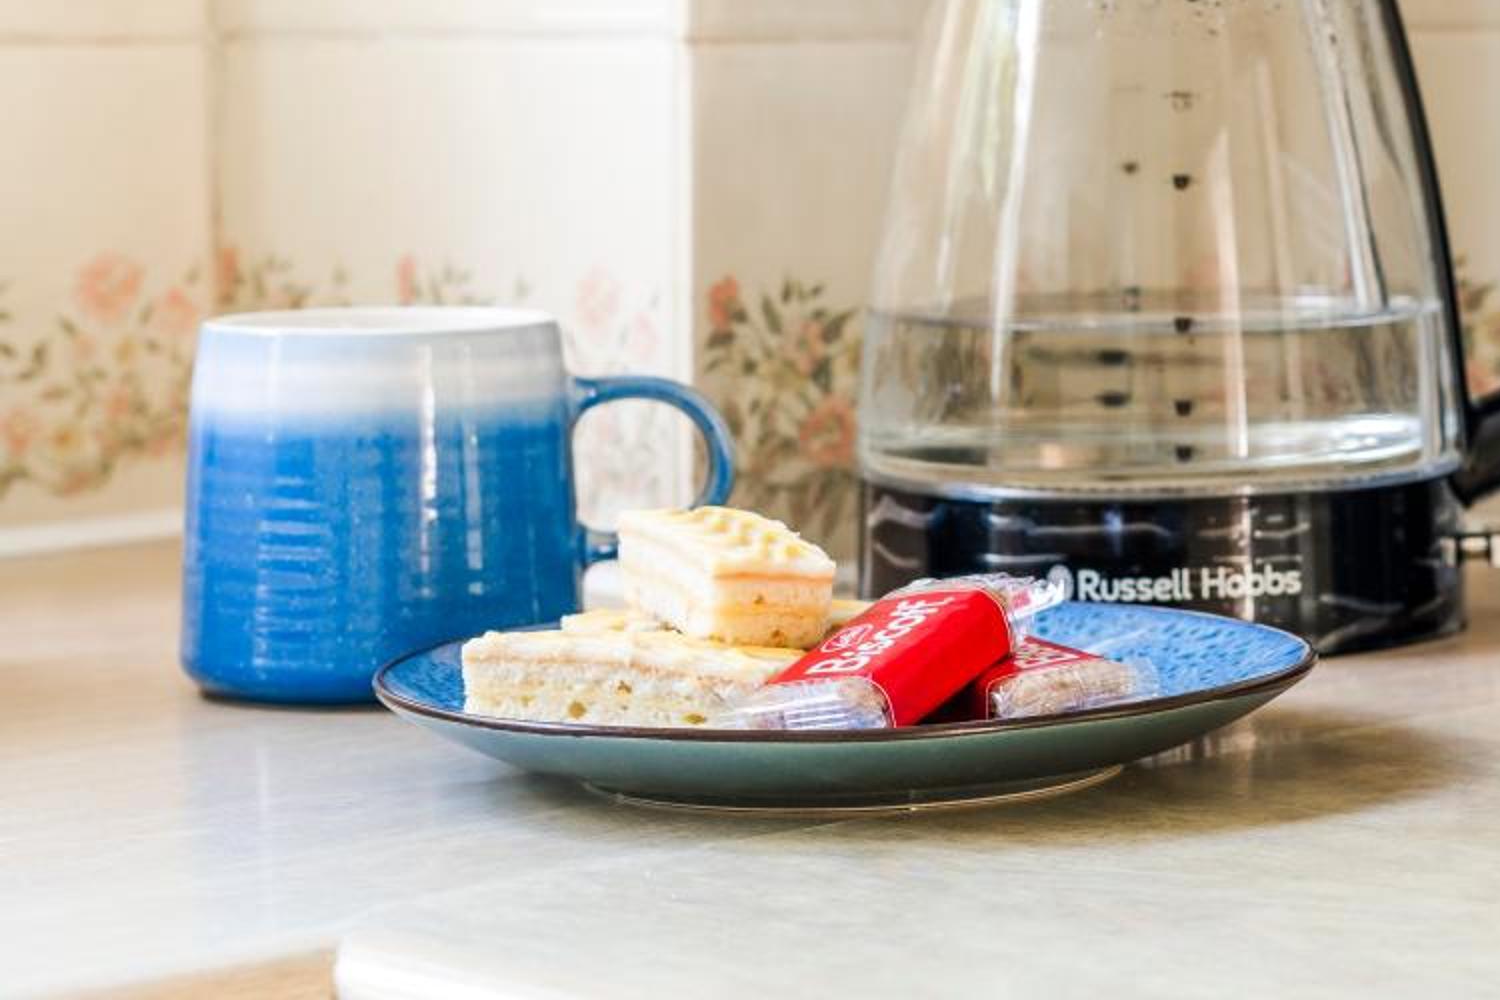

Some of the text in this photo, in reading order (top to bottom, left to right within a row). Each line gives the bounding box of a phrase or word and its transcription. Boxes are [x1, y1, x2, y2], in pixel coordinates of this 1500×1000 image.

[1077, 563, 1302, 601] Russell Hobbs
[804, 597, 955, 673] Biscoff
